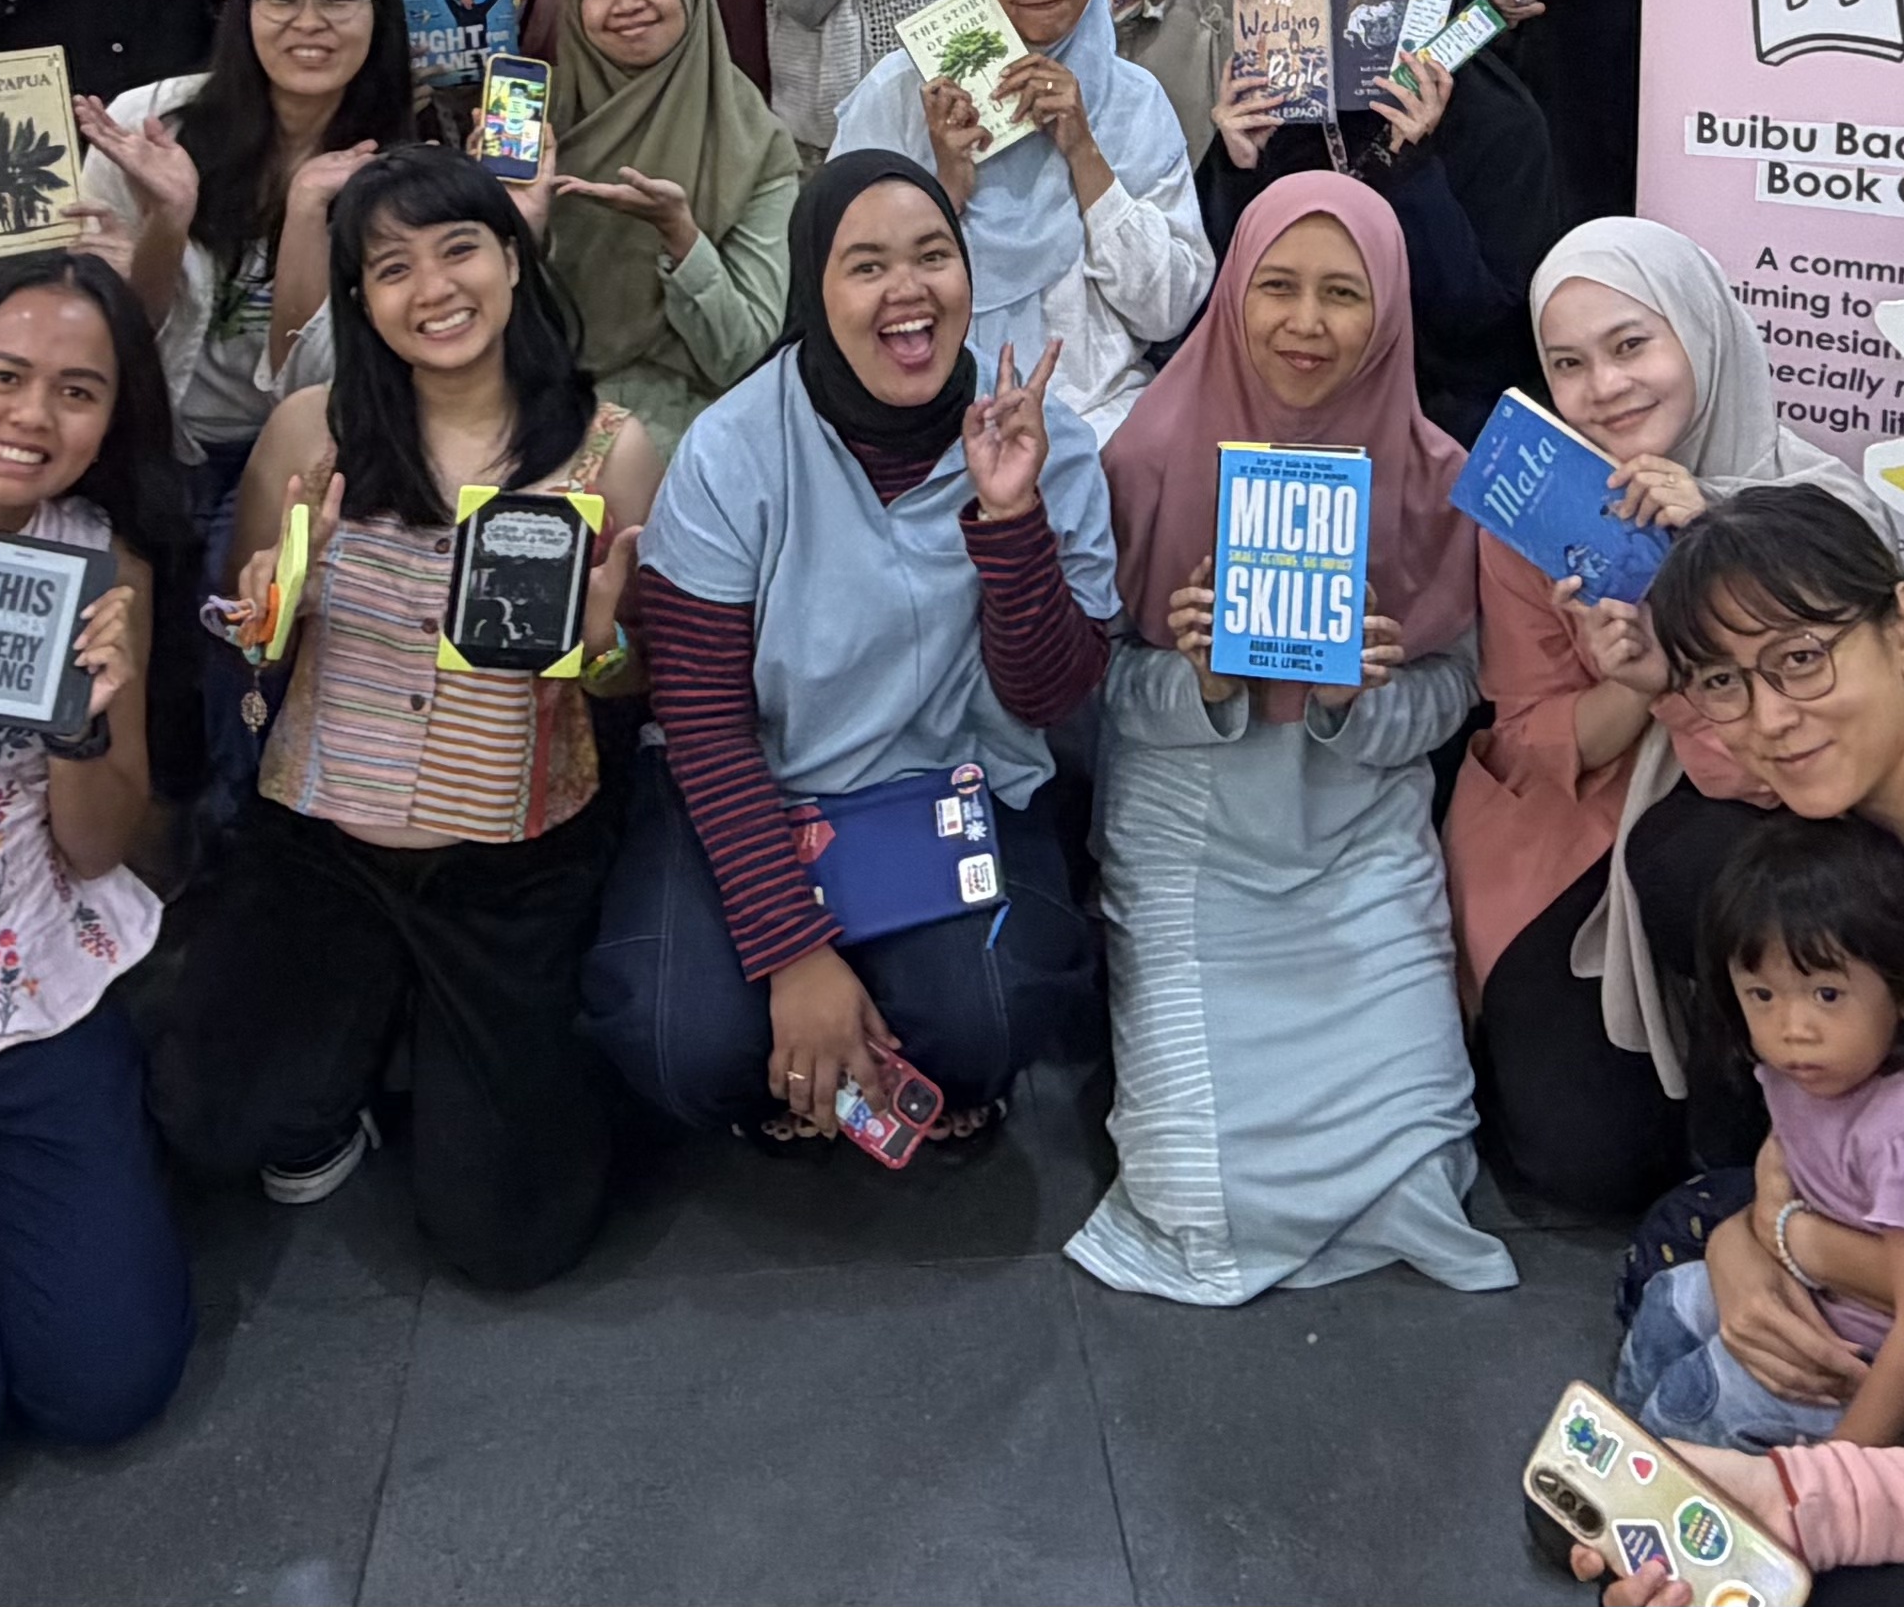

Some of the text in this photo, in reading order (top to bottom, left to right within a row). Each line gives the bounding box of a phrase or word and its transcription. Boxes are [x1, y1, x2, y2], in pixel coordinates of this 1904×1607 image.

[909, 20, 941, 42] THE
[926, 34, 947, 52] OF
[1239, 9, 1321, 40] Wedding
[1268, 54, 1329, 100] People
[1695, 110, 1818, 153] Buibu
[1766, 162, 1883, 204] Book
[1755, 246, 1779, 271] A
[1840, 290, 1873, 318] to
[1756, 320, 1902, 360] donesian
[1769, 359, 1885, 399] ecially
[1775, 400, 1871, 433] rough
[1483, 436, 1557, 529] Mata
[1229, 476, 1358, 556] MICRO
[1224, 565, 1354, 643] SKILLS
